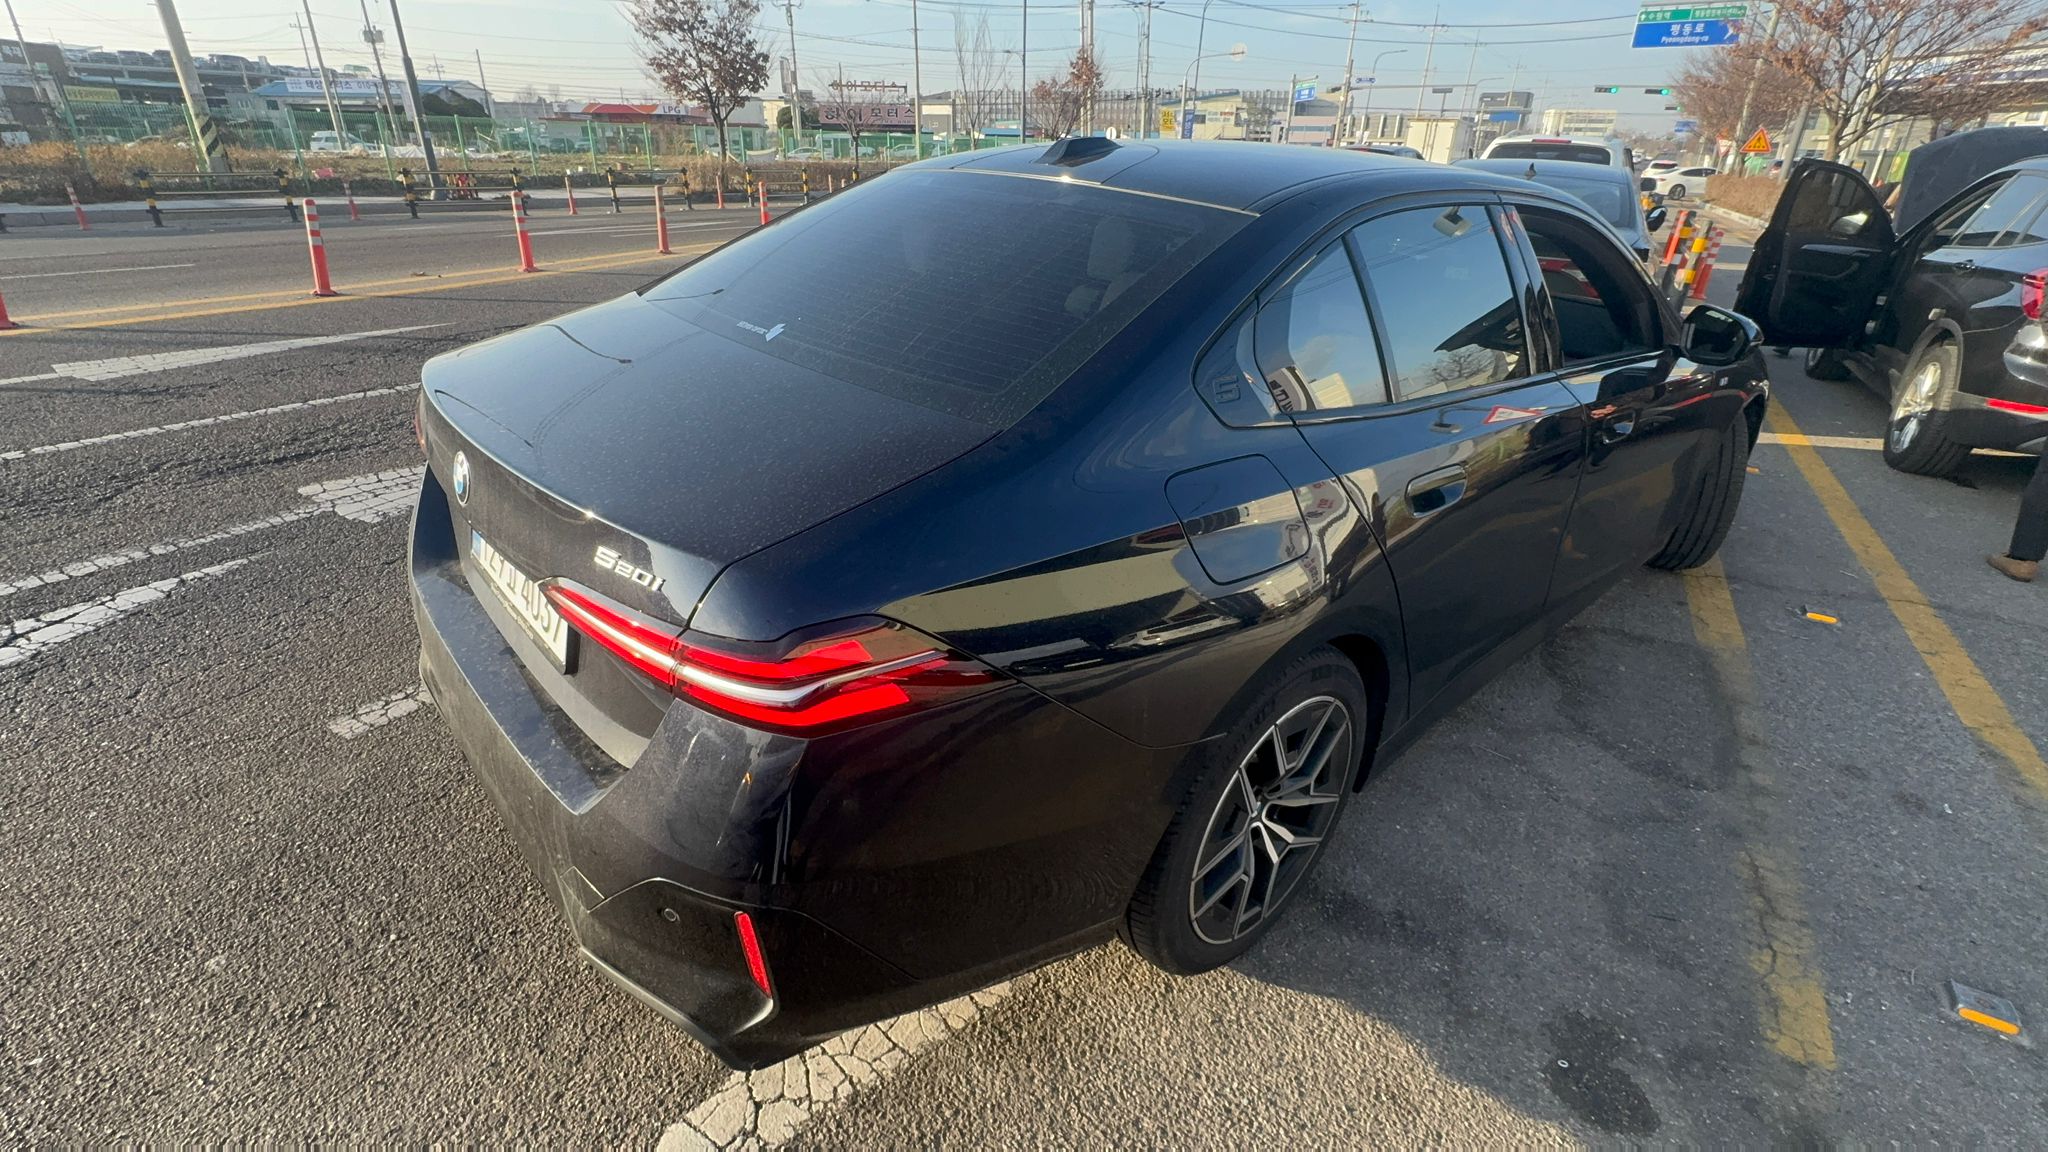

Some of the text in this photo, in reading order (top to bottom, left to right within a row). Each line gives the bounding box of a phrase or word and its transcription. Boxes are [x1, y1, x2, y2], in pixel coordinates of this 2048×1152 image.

[1670, 23, 1705, 36] 평동로
[1661, 35, 1710, 44] Pyeongdong-ro
[662, 105, 681, 114] LPG
[594, 545, 664, 592] 520i
